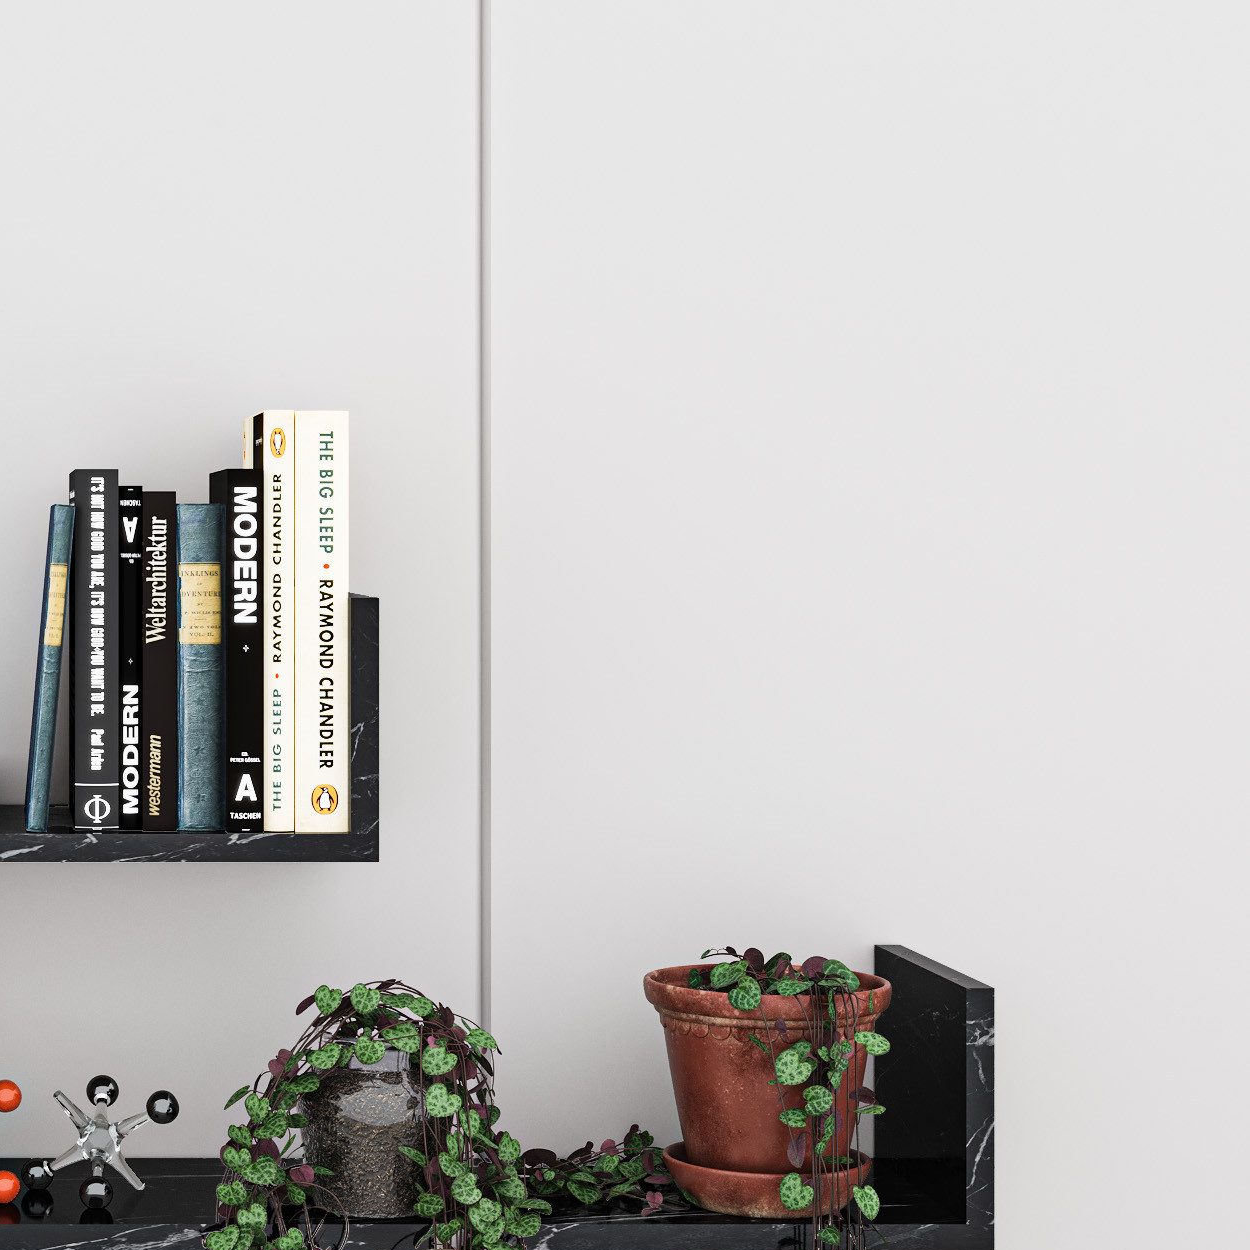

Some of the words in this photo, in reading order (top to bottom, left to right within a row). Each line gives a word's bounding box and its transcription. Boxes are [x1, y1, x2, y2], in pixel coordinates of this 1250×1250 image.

[319, 431, 335, 461] THE
[319, 470, 335, 499] BIG
[90, 494, 105, 509] NOT
[90, 511, 105, 529] HOW
[273, 474, 282, 566] CHANDLER
[319, 508, 335, 554] SLEEP
[90, 531, 105, 551] GOOD
[234, 487, 257, 623] MODERN
[90, 553, 105, 569] YOU
[146, 516, 167, 644] Weltarchitektur
[90, 608, 105, 625] HOW
[273, 574, 282, 663] RAYMOND
[319, 579, 335, 669] RAYMOND
[90, 668, 105, 689] WANT
[90, 692, 105, 702] TO
[273, 689, 282, 735] SLEEP
[319, 676, 335, 769] CHANDLER
[123, 685, 139, 814] MODERN
[273, 744, 282, 773] BIG
[147, 735, 161, 816] westermann
[235, 774, 258, 801] A
[273, 782, 282, 812] THE
